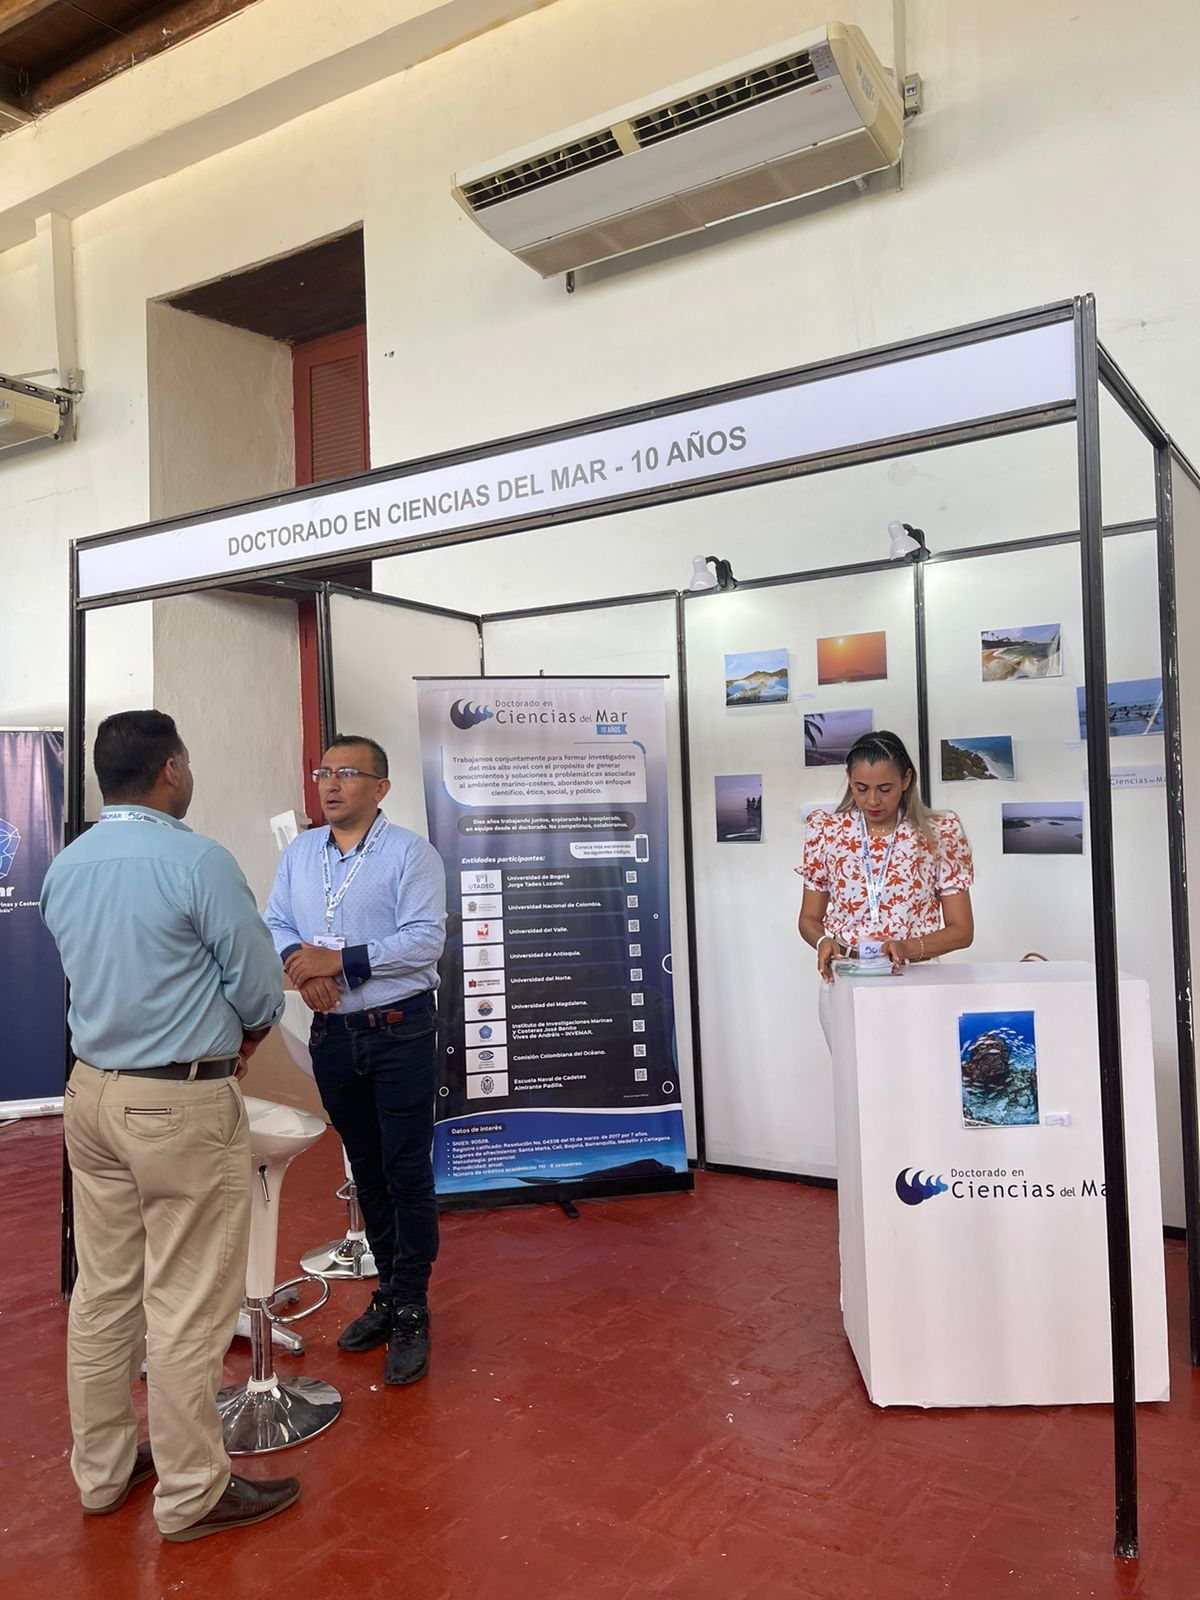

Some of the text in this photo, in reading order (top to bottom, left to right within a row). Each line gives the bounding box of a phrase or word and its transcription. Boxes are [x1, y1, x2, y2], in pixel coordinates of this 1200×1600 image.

[228, 514, 348, 556] DOCTORADO
[354, 507, 381, 531] EN
[388, 484, 490, 524] CIENCIAS
[498, 474, 544, 502] DEL
[551, 459, 608, 492] MAR
[631, 446, 659, 473] 10
[666, 426, 748, 466] AÑOS
[495, 700, 540, 708] Doctorado
[496, 709, 628, 724] Ciencias del Mar
[497, 855, 546, 864] participantes:
[546, 1019, 590, 1027] Investigaciones
[540, 1052, 573, 1060] Colombiana
[951, 1168, 1024, 1178] Doctorado en
[952, 1180, 1107, 1198] Ciencias del Ma
